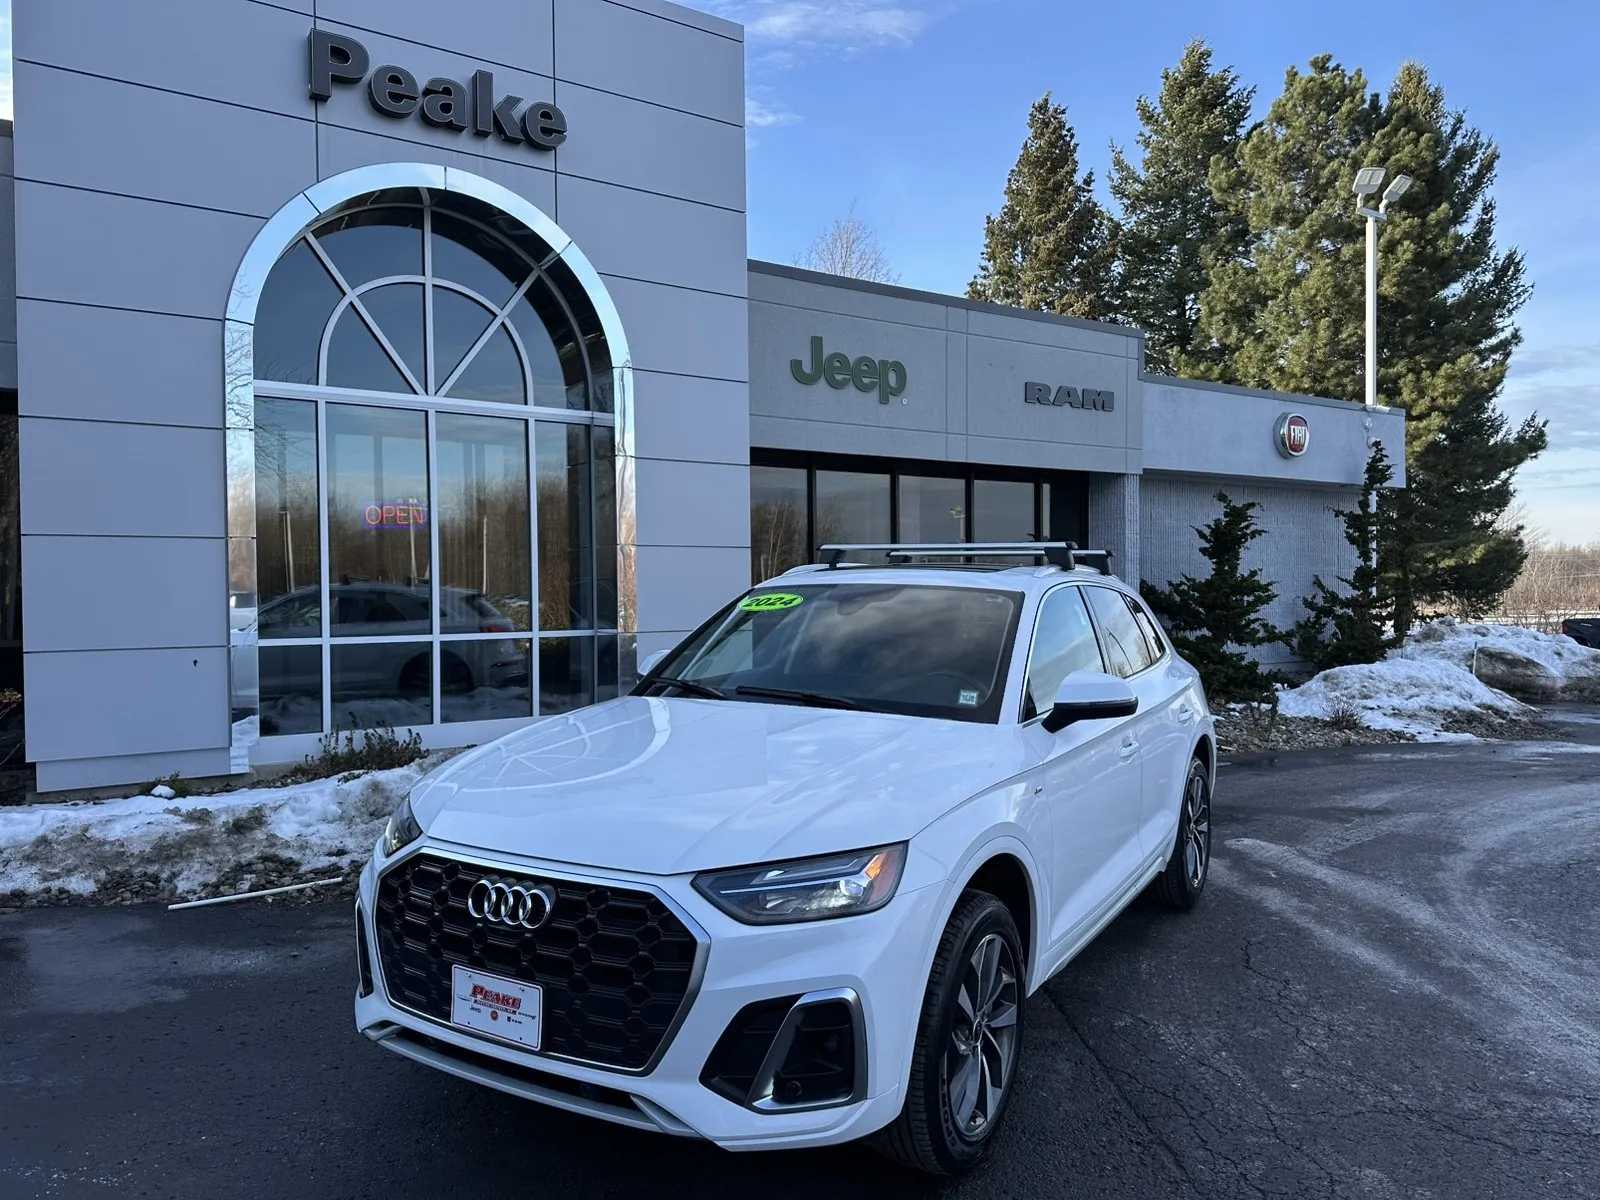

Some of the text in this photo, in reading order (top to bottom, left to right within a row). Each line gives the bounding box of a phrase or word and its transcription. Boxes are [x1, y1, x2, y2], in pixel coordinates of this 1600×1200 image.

[308, 28, 567, 151] Peake
[790, 336, 907, 404] Jeep
[1024, 382, 1115, 412] RAM
[1290, 425, 1306, 445] FIAT
[365, 505, 424, 525] OPEN
[741, 597, 798, 607] 2024
[469, 983, 521, 1010] PEAKE
